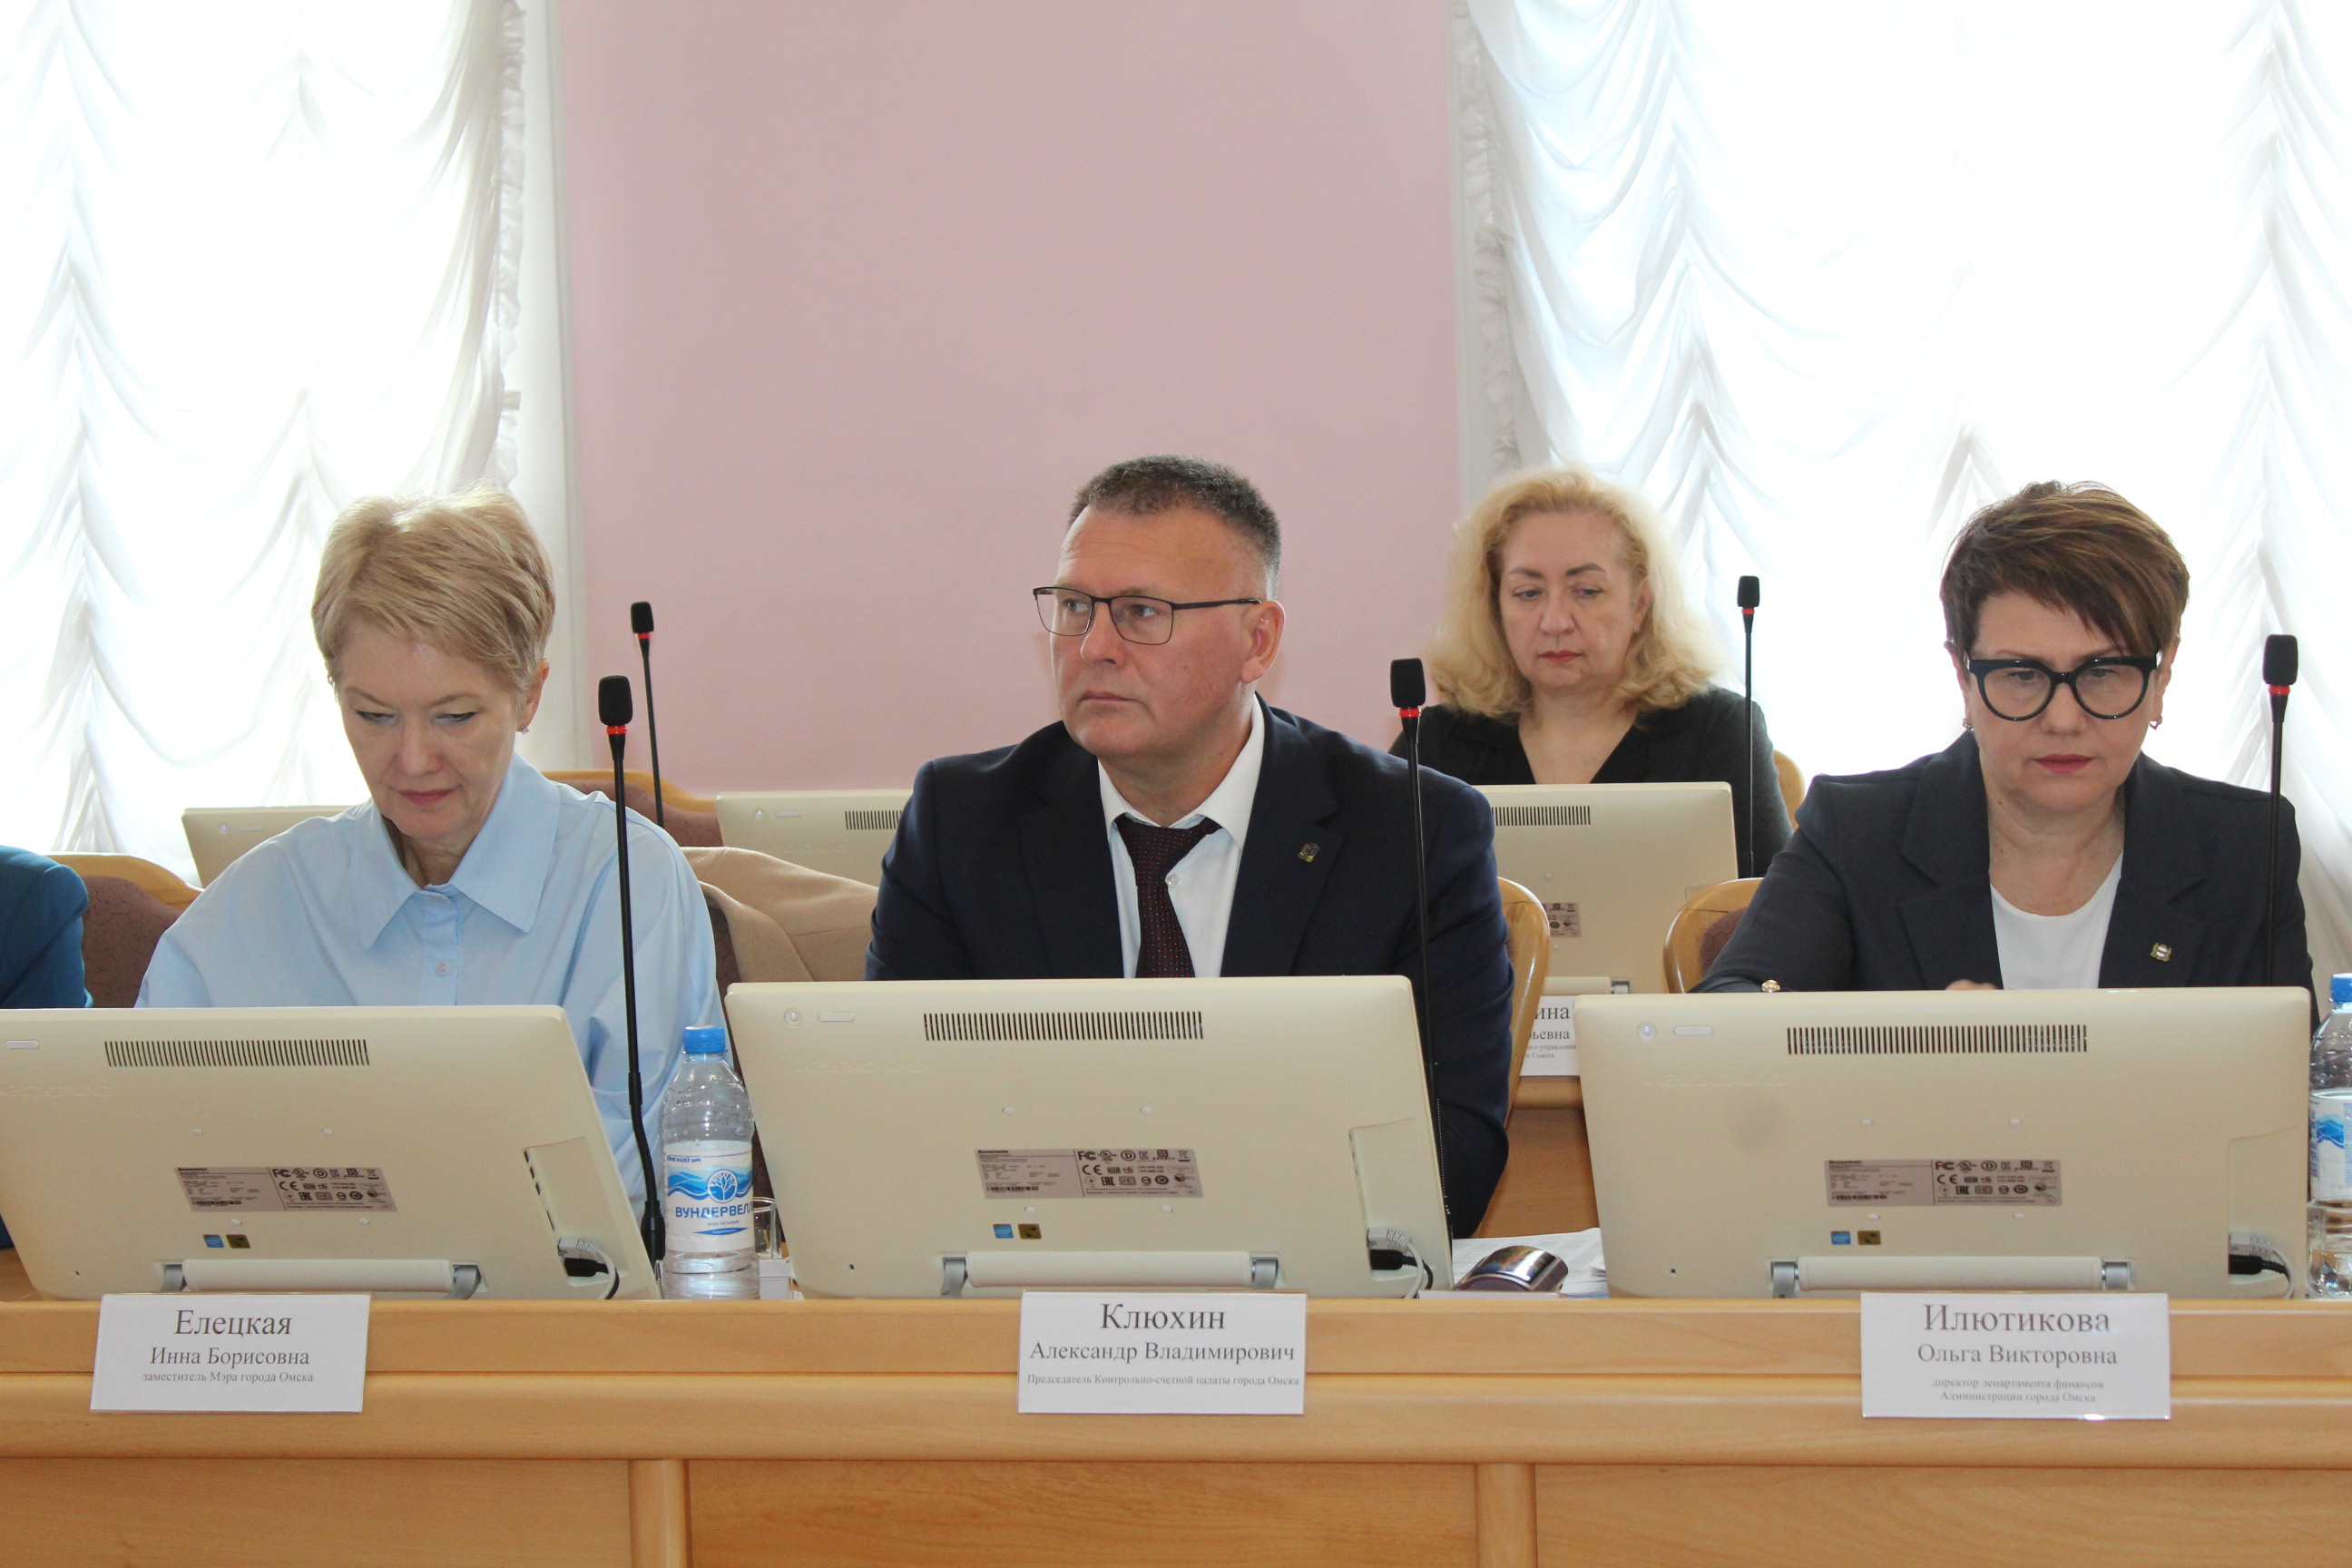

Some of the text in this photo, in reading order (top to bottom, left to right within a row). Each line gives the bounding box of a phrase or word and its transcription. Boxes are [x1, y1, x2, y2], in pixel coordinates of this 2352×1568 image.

[1534, 1006, 1571, 1020] ина
[1530, 1030, 1570, 1040] ьевна
[0, 1084, 116, 1100] enovo
[173, 1309, 292, 1338] Елецкая
[1101, 1303, 1225, 1329] Клюхин
[1924, 1304, 2109, 1332] Илютикова
[151, 1347, 309, 1369] Инна Борисовна
[1030, 1341, 1294, 1365] Александр Владимирович
[1917, 1343, 2118, 1369] Ольга Викторовна
[142, 1371, 314, 1385] заместитель Мэра города Омска
[1027, 1374, 1093, 1386] Председатель
[1196, 1377, 1230, 1385] палаты
[1232, 1377, 1266, 1387] города
[1268, 1376, 1299, 1386] Омска
[1932, 1379, 1979, 1389] директор
[2025, 1394, 2060, 1405] города
[2062, 1392, 2096, 1402] Омска
